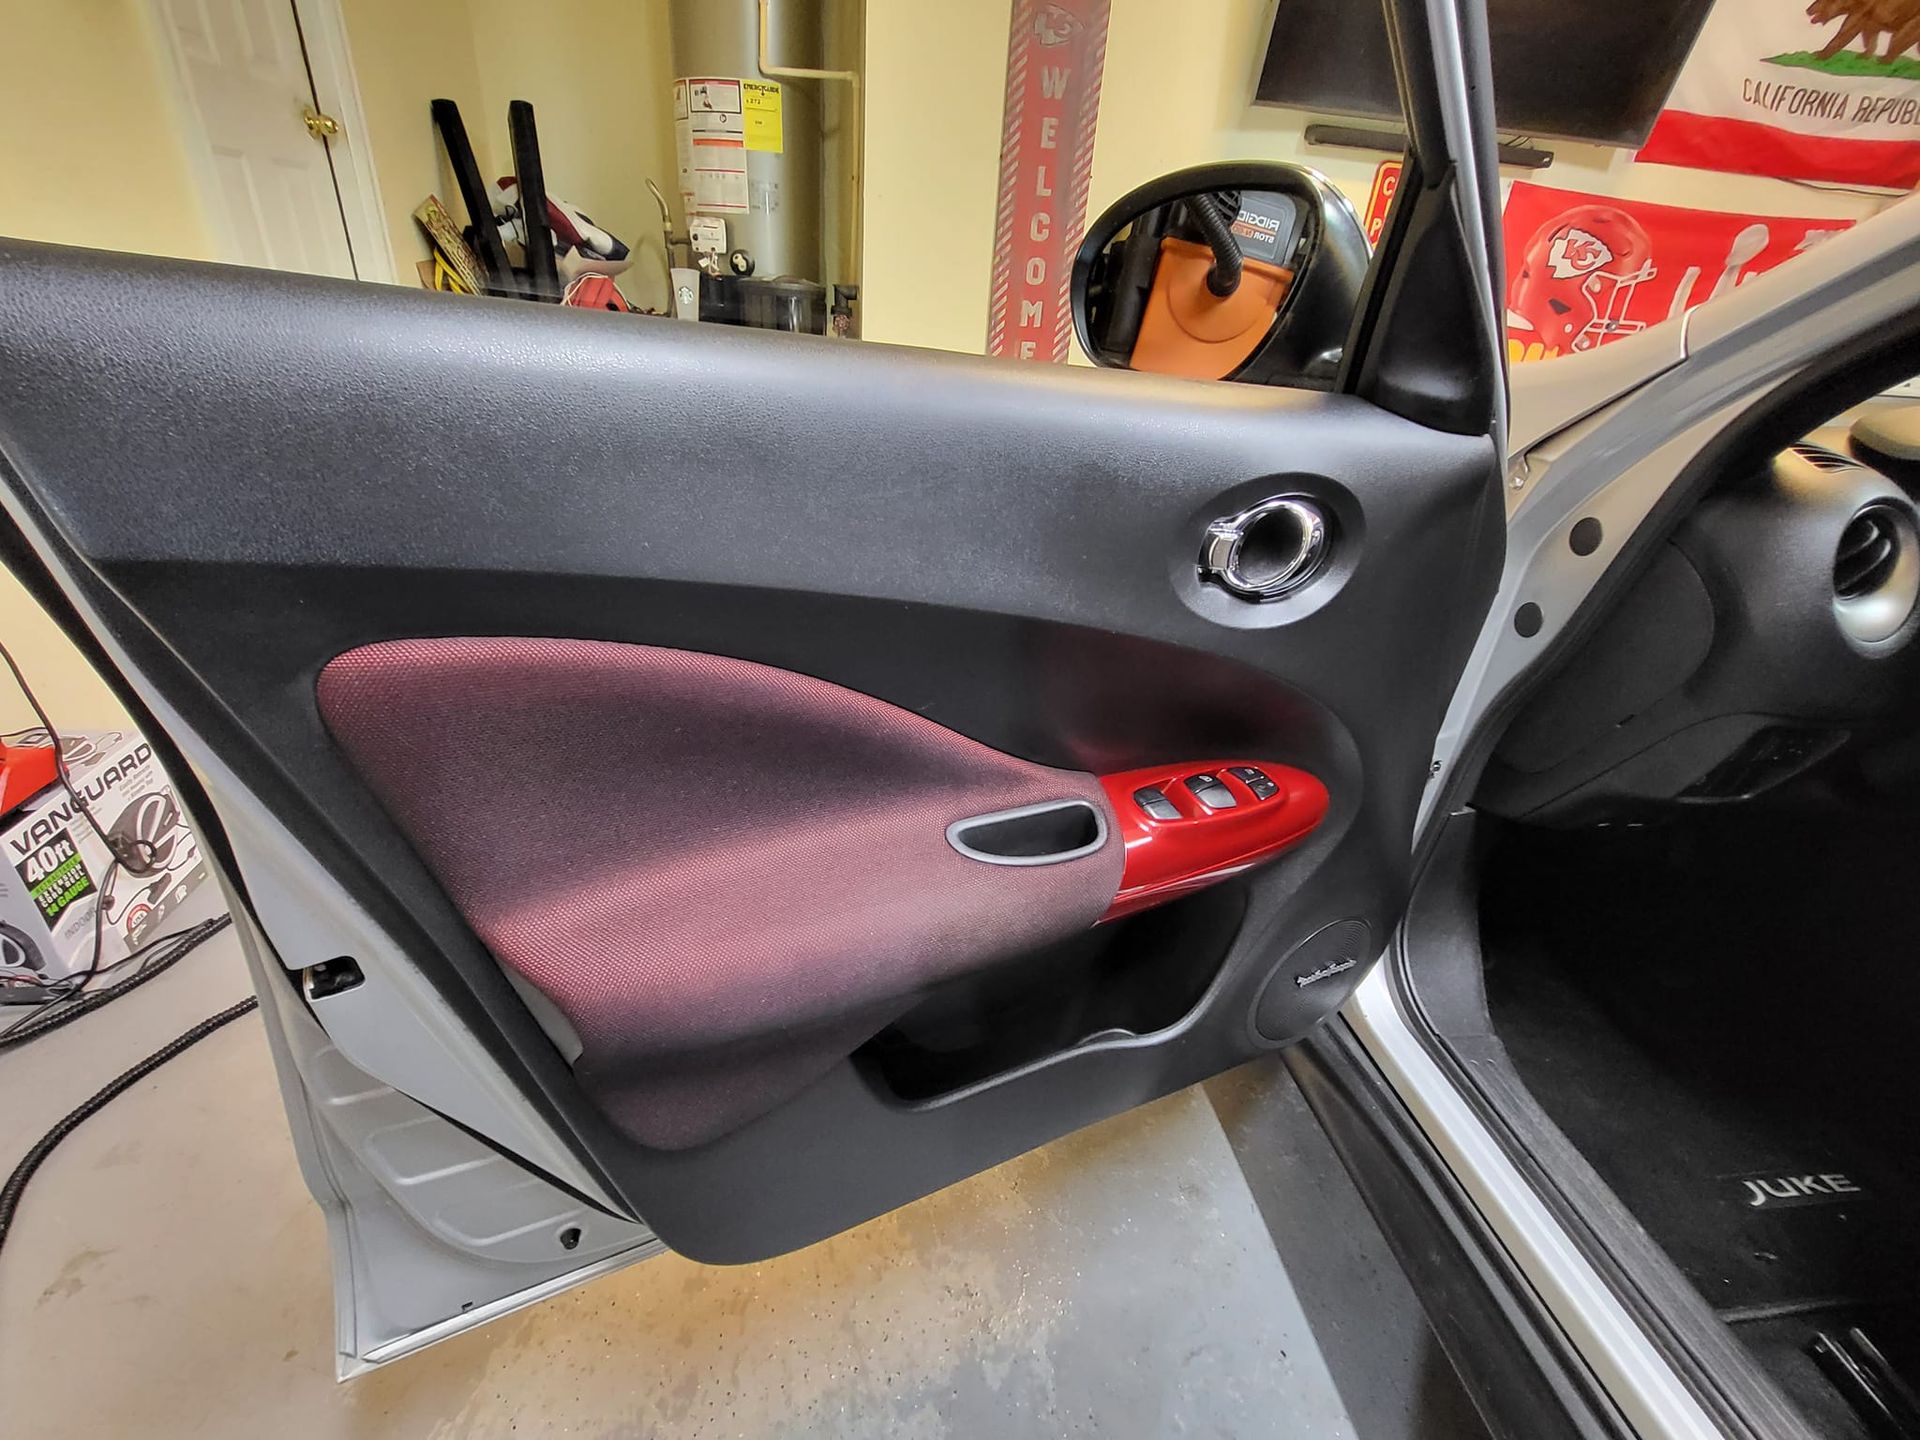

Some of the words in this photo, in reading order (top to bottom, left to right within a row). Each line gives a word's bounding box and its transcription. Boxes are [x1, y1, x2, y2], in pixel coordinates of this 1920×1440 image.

[1742, 77, 1850, 121] CALIFORNIA
[1018, 66, 1071, 360] WELCOME
[10, 742, 152, 856] VANGUARD
[26, 839, 74, 883] 40ft
[38, 862, 83, 902] EXTENSION
[42, 887, 63, 908] CORD
[56, 876, 90, 909] GAUGE
[1742, 1173, 1862, 1208] JUKE
